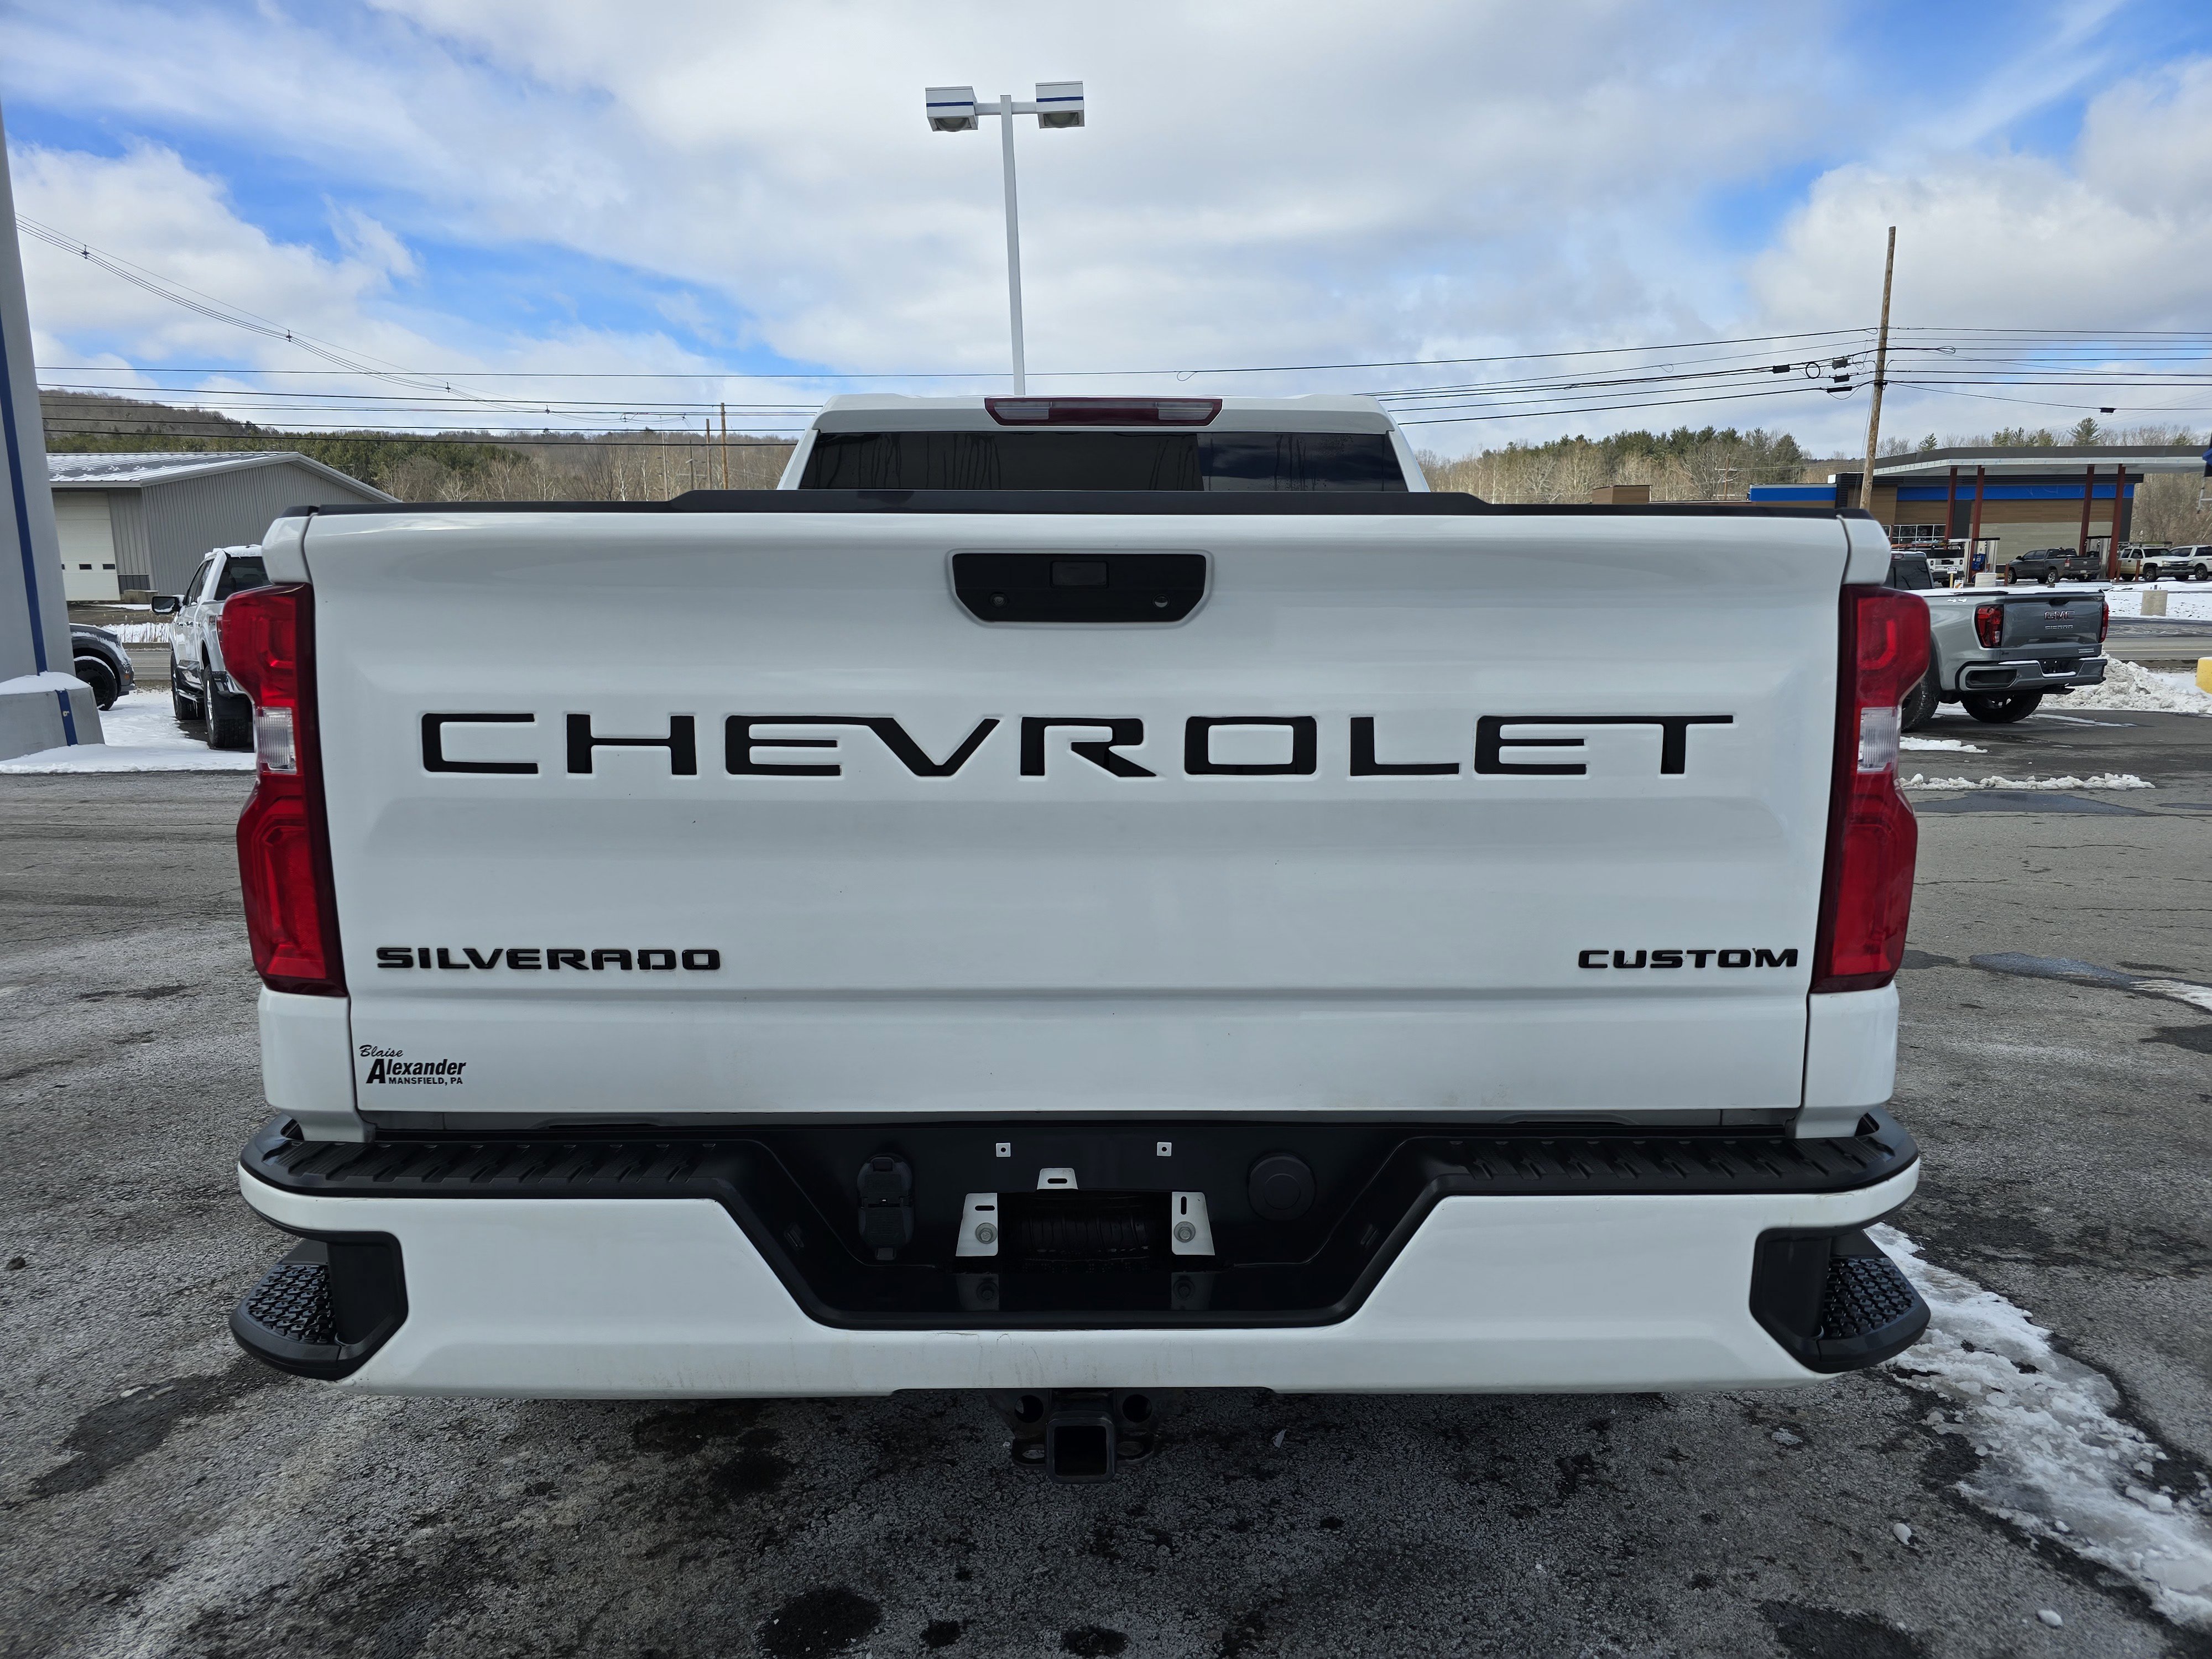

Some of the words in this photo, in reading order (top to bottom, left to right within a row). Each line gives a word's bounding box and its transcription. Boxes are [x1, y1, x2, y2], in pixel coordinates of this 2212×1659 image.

[2044, 611, 2075, 620] GMC
[422, 713, 1733, 777] CHEVROLET
[377, 947, 721, 971] SILVERADO
[1578, 948, 1798, 969] CUSTOM
[359, 1044, 404, 1057] Blaise
[366, 1058, 467, 1084] Alexander
[389, 1077, 448, 1086] MANSFIELD,
